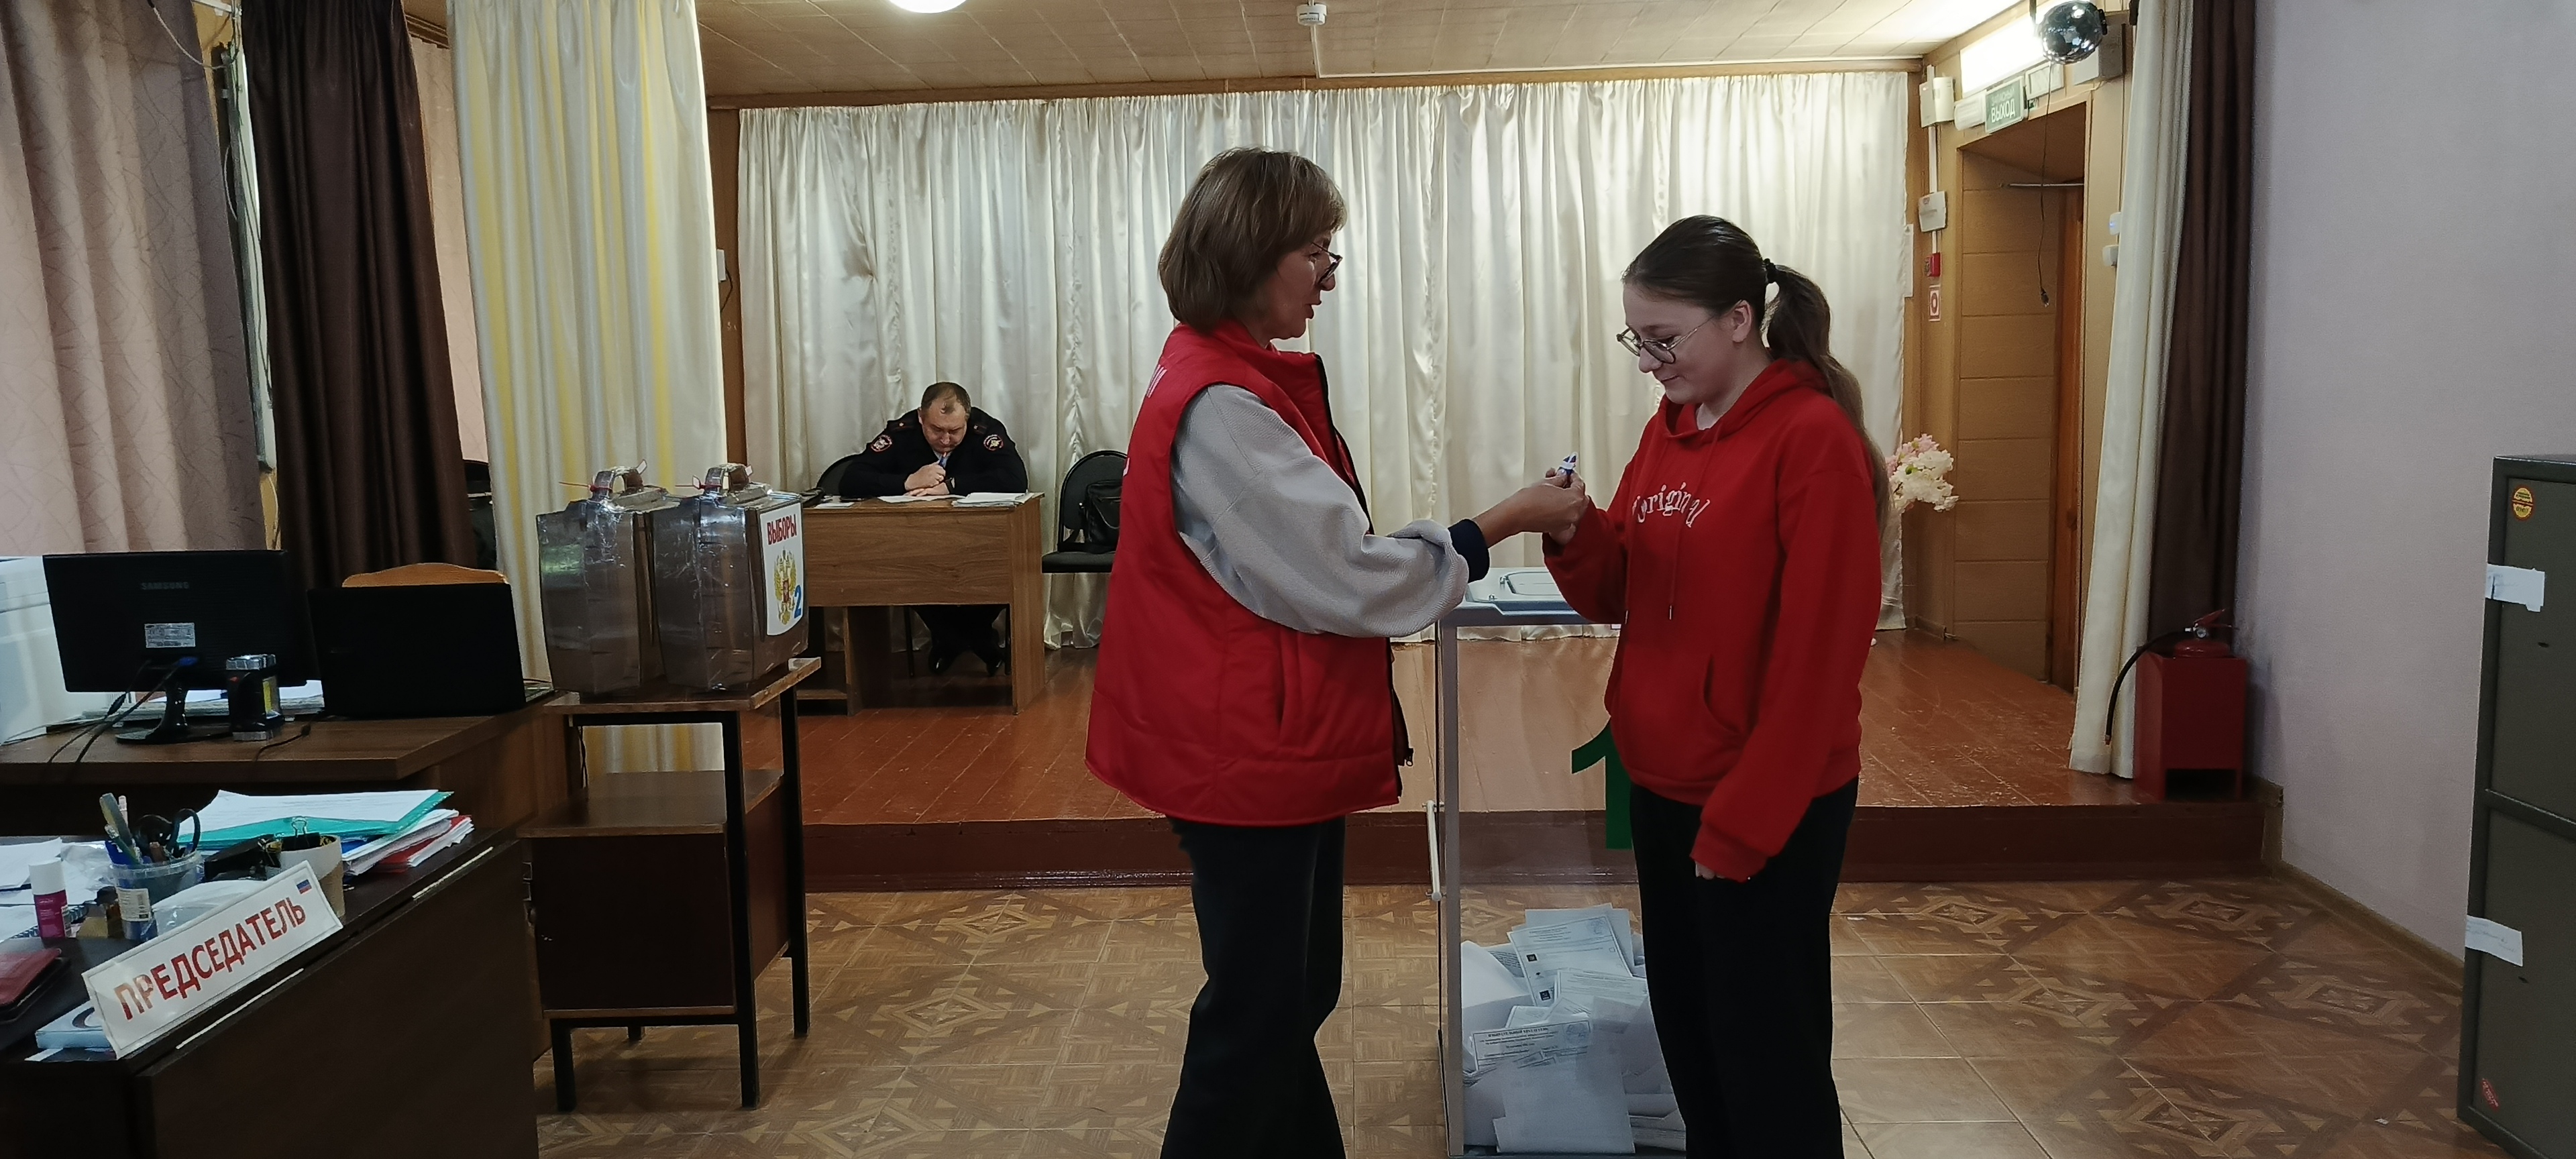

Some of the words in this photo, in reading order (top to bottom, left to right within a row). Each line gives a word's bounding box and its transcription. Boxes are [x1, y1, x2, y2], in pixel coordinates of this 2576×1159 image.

[1991, 98, 2016, 123] ВЫХОД
[767, 514, 797, 545] ВЫБОРЫ
[794, 584, 802, 619] 2
[1571, 723, 1633, 849] 1
[113, 897, 307, 1021] ПРЕДСЕДАТЕЛЬ
